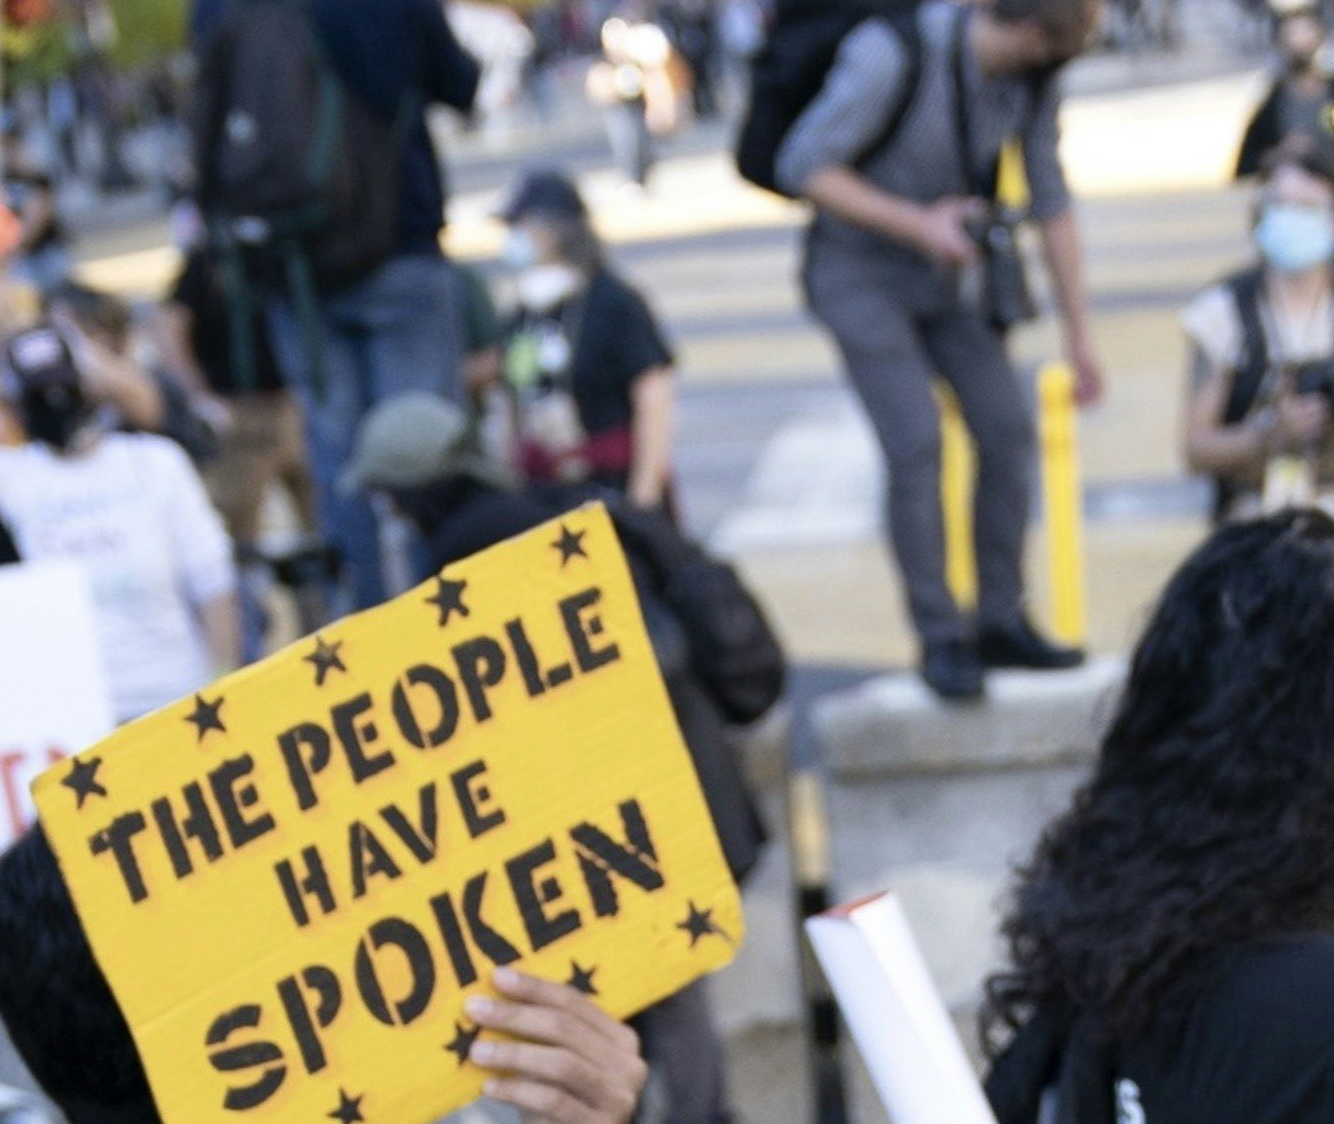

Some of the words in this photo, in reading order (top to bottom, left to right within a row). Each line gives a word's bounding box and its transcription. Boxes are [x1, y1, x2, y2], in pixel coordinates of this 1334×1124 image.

[89, 753, 276, 904] THE
[277, 586, 622, 812] PEOPLE
[274, 759, 508, 928] HAVE
[204, 797, 666, 1112] SPOKEN
